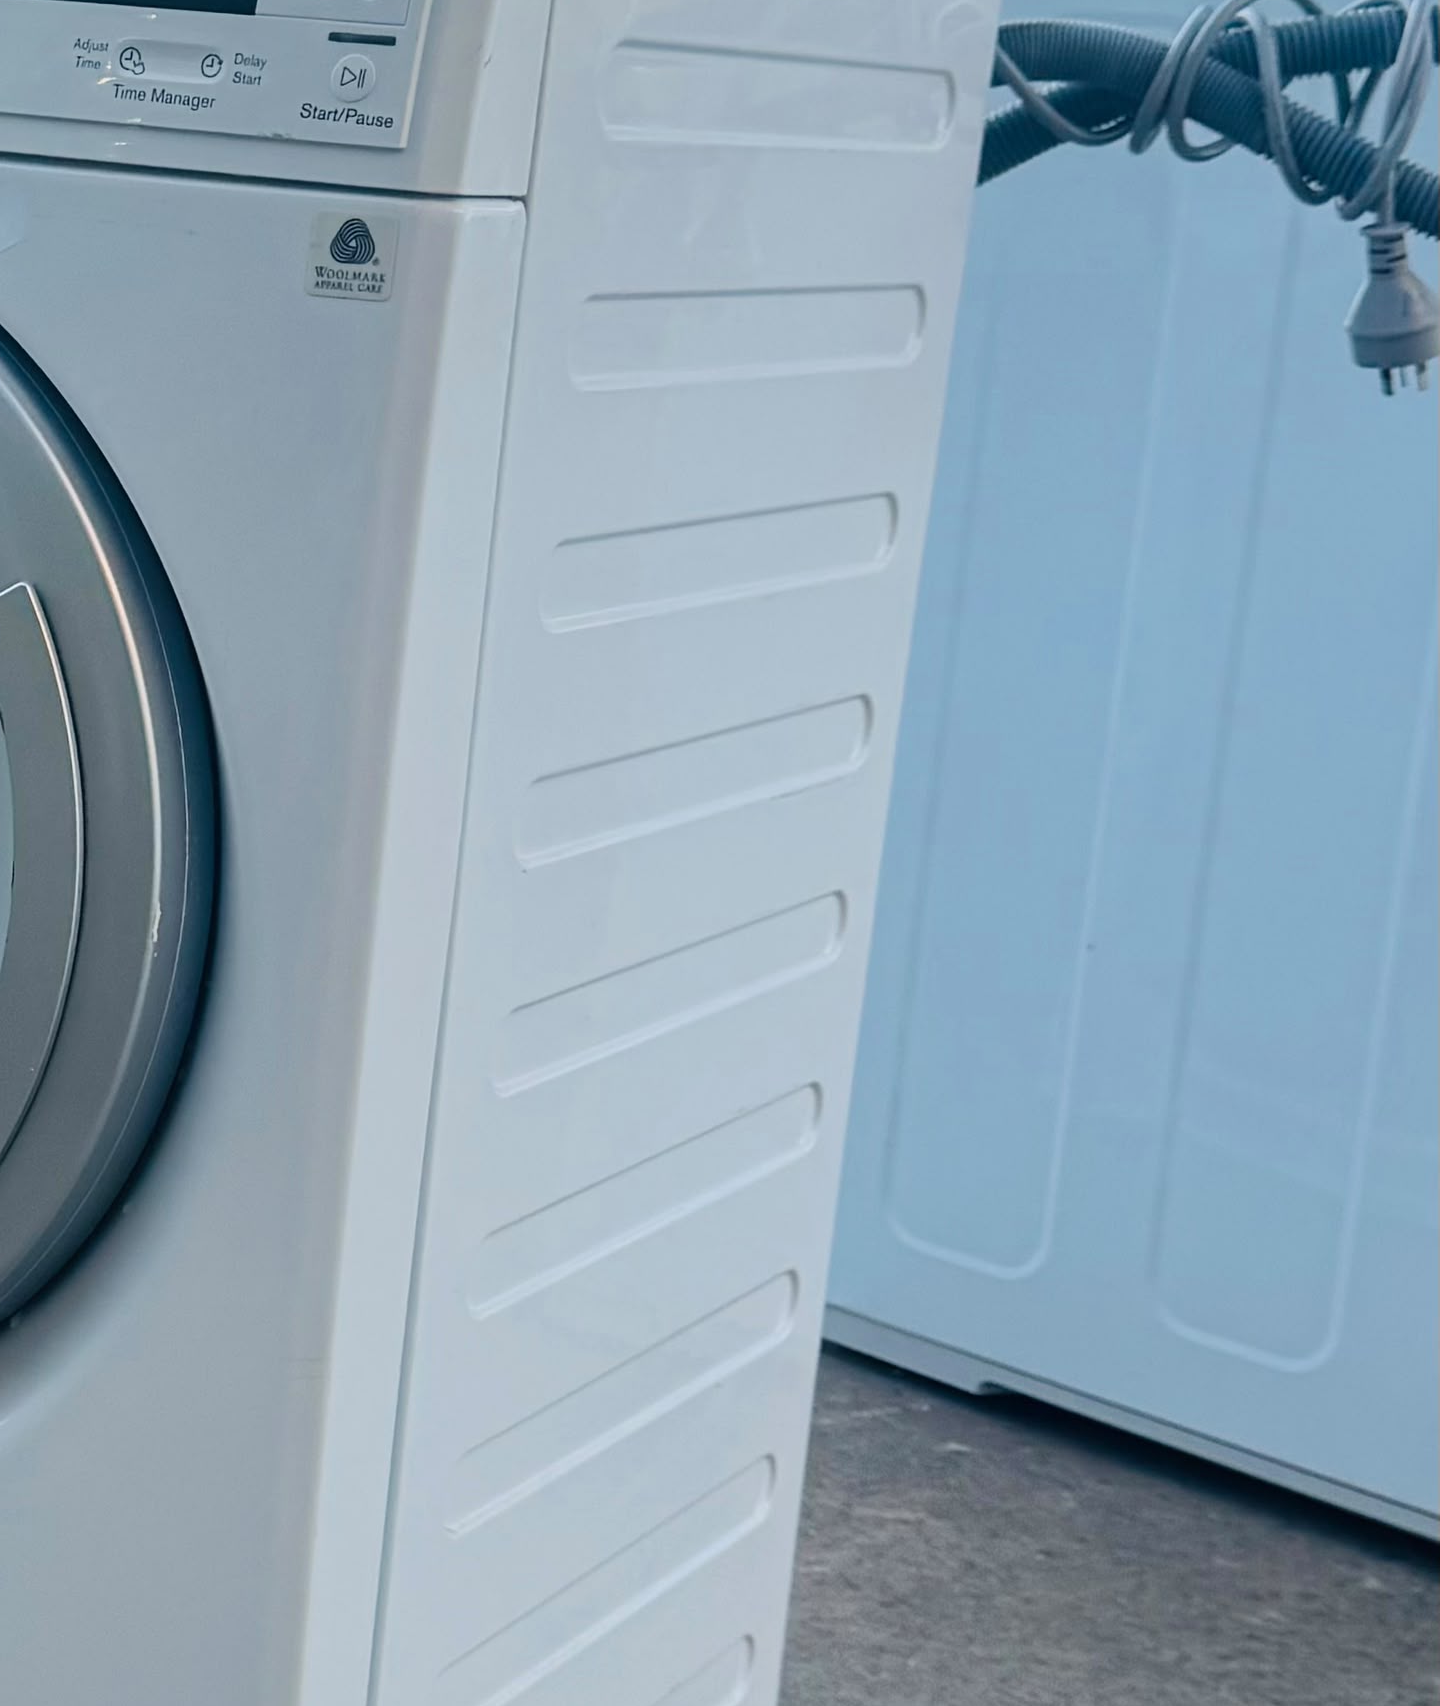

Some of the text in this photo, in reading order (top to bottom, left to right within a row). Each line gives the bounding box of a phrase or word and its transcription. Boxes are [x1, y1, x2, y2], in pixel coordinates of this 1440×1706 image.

[73, 37, 109, 53] Adjust
[74, 56, 101, 70] Time
[234, 52, 267, 69] Delay
[232, 71, 262, 86] Start
[113, 84, 216, 111] Time Manager
[299, 103, 394, 129] Start/Pause
[315, 266, 386, 282] WOOLMARK
